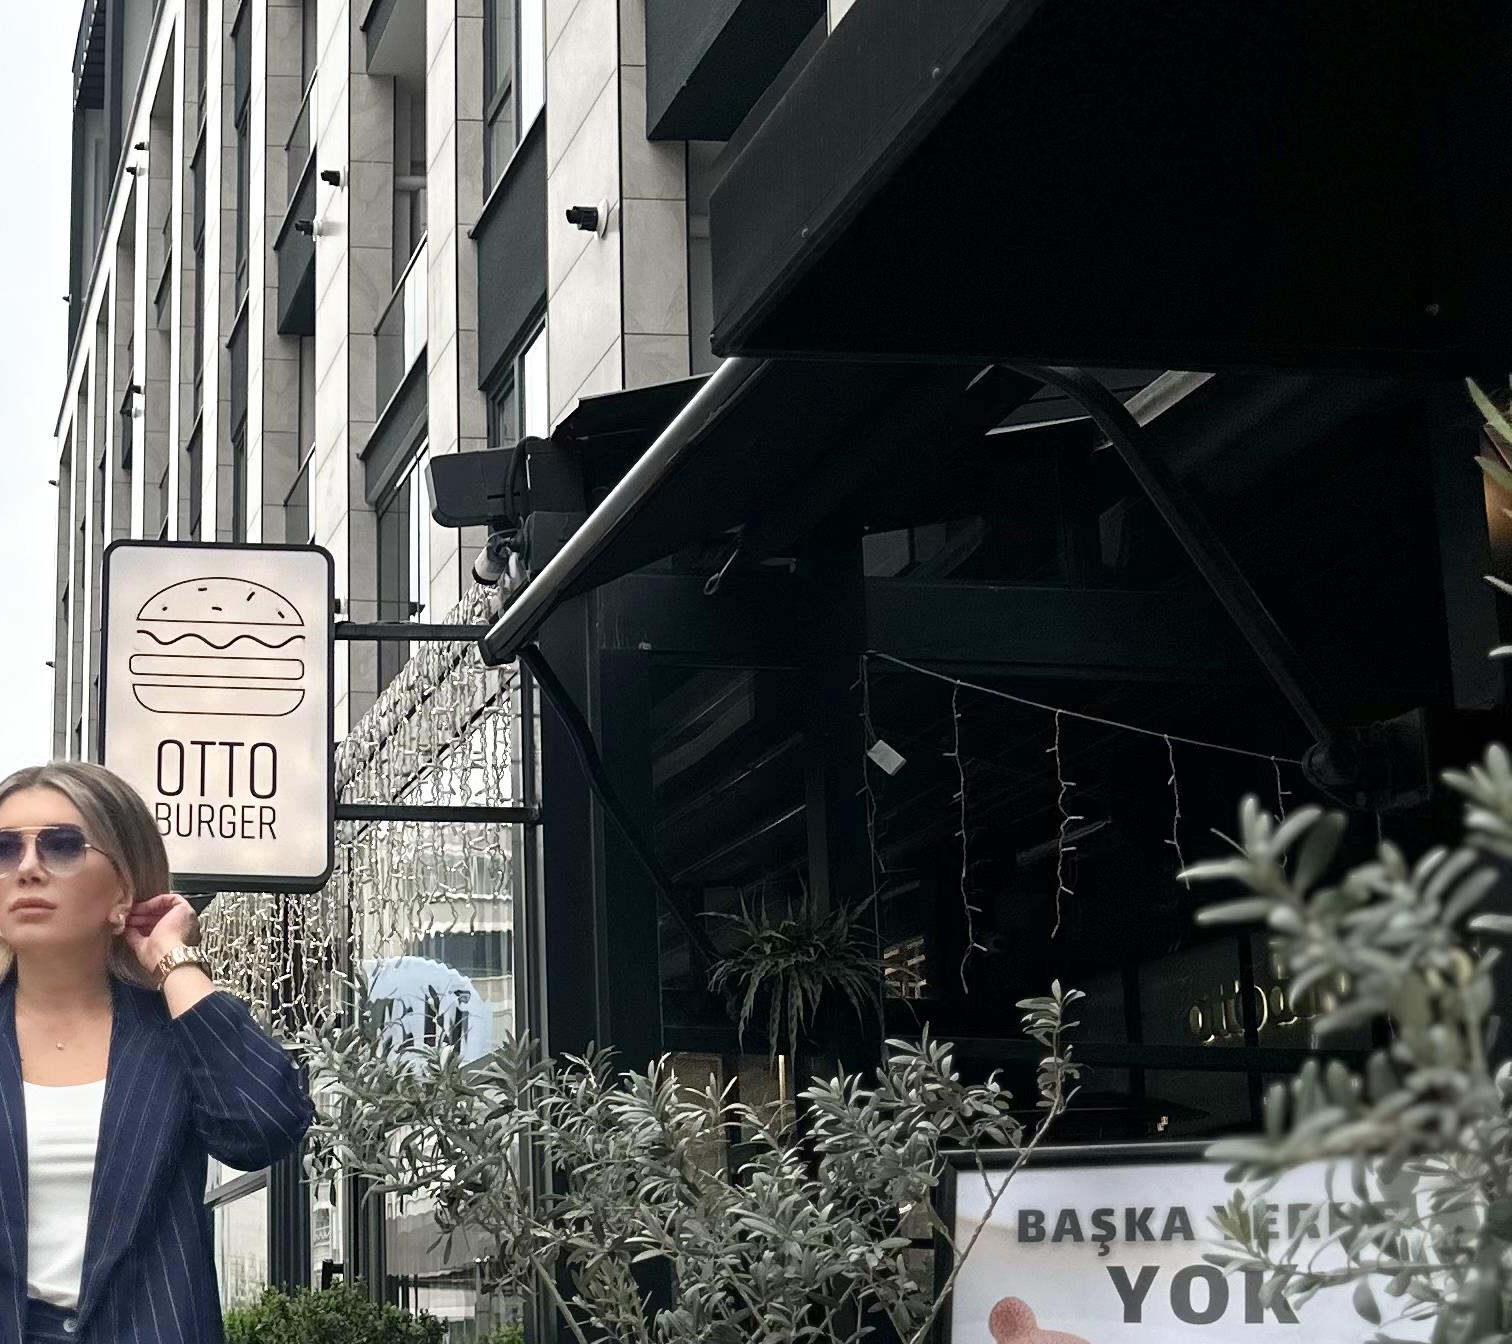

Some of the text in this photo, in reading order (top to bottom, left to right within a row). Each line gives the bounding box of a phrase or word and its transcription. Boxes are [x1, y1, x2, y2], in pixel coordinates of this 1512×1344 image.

[157, 739, 277, 799] OTTO
[155, 802, 276, 840] BURGER
[1017, 1206, 1196, 1256] BAŞKA
[1106, 1264, 1300, 1324] YOK
